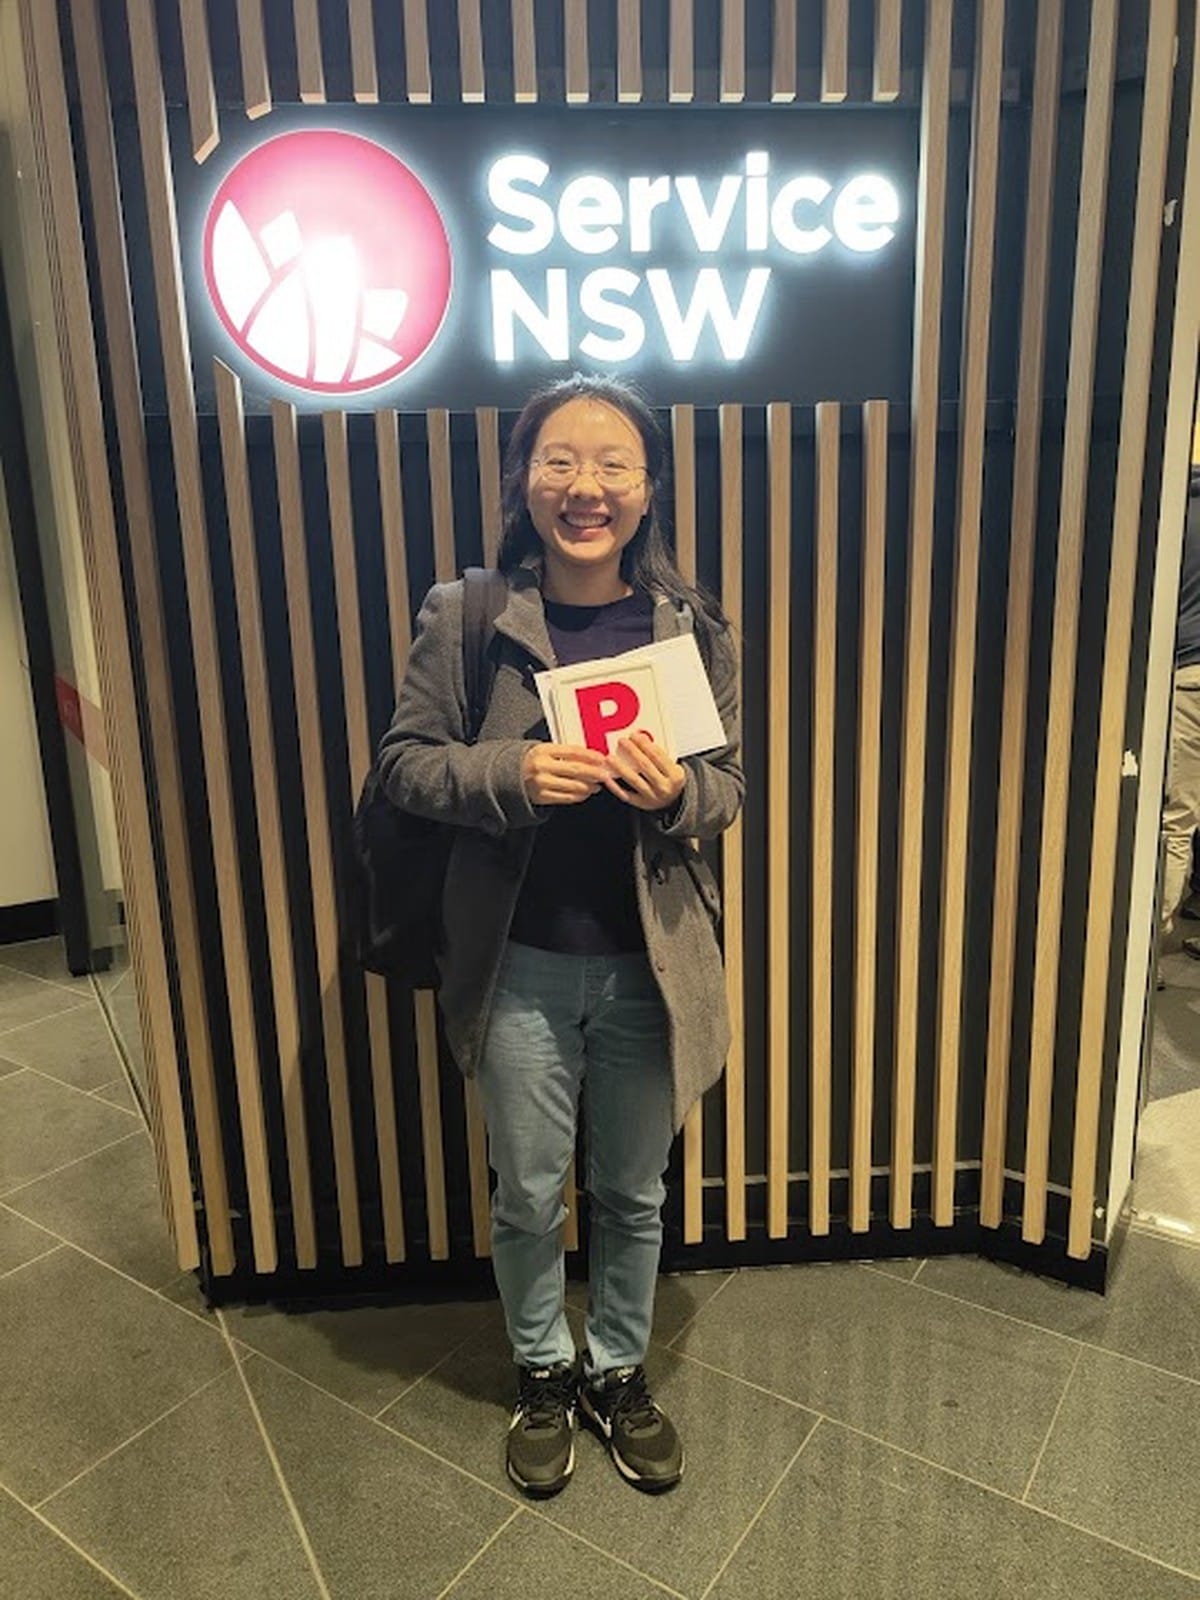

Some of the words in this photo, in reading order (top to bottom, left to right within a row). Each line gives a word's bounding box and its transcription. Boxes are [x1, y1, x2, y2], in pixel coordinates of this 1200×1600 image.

[487, 150, 900, 254] Service
[490, 267, 772, 363] NSW
[575, 682, 640, 756] P
